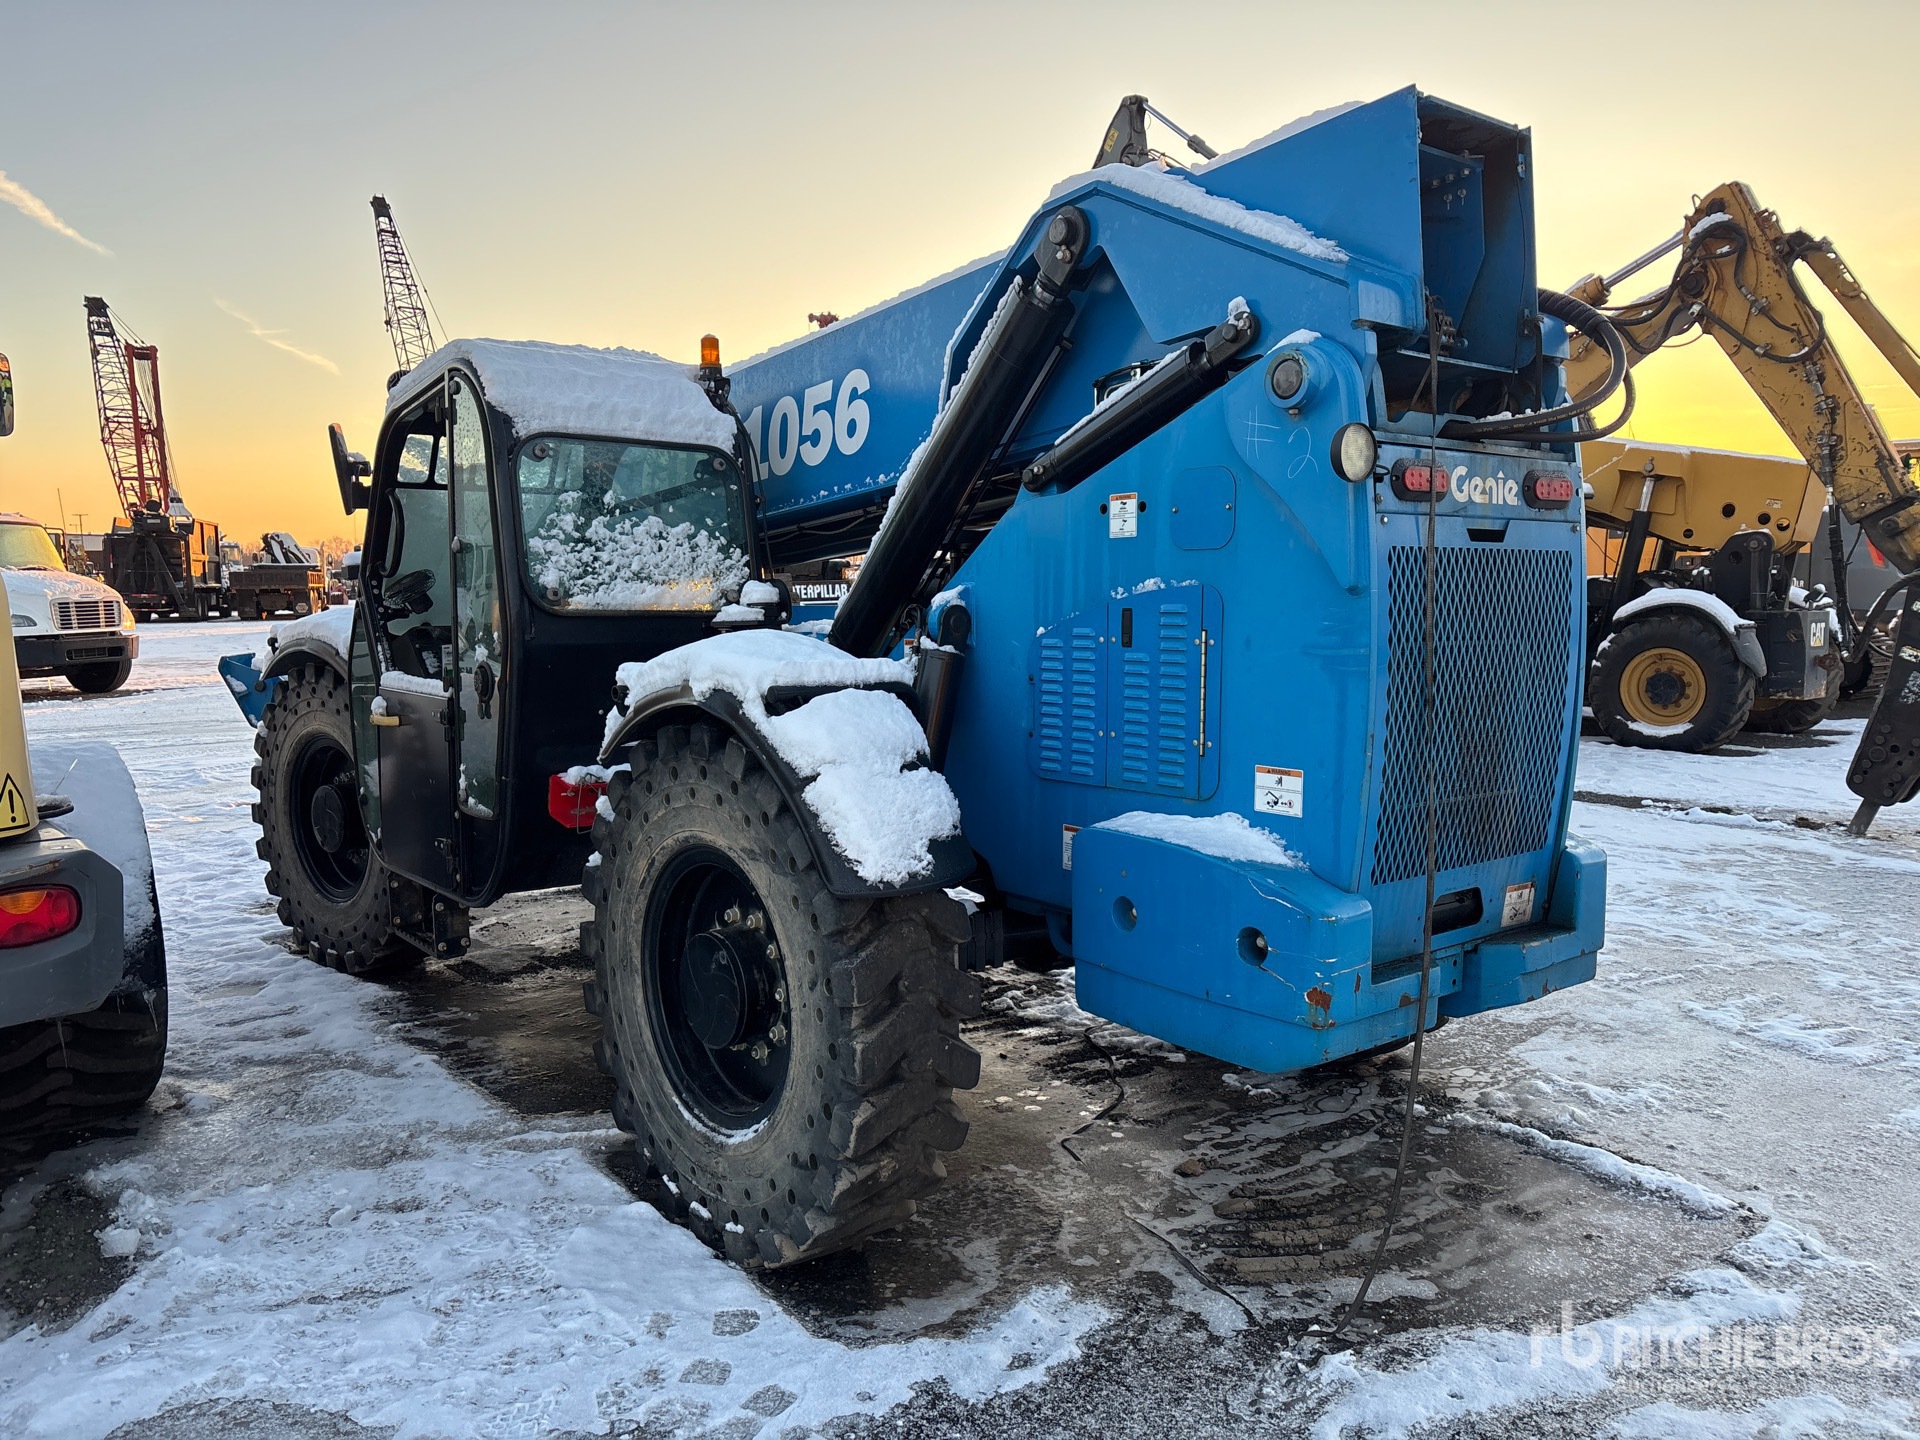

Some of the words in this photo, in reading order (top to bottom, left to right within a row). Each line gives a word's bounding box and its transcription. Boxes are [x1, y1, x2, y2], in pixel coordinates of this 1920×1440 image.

[744, 368, 871, 482] 1056
[1241, 405, 1319, 479] #2
[1450, 465, 1518, 506] Genie
[792, 584, 848, 599] TERPILLAR
[1810, 622, 1826, 647] CAT
